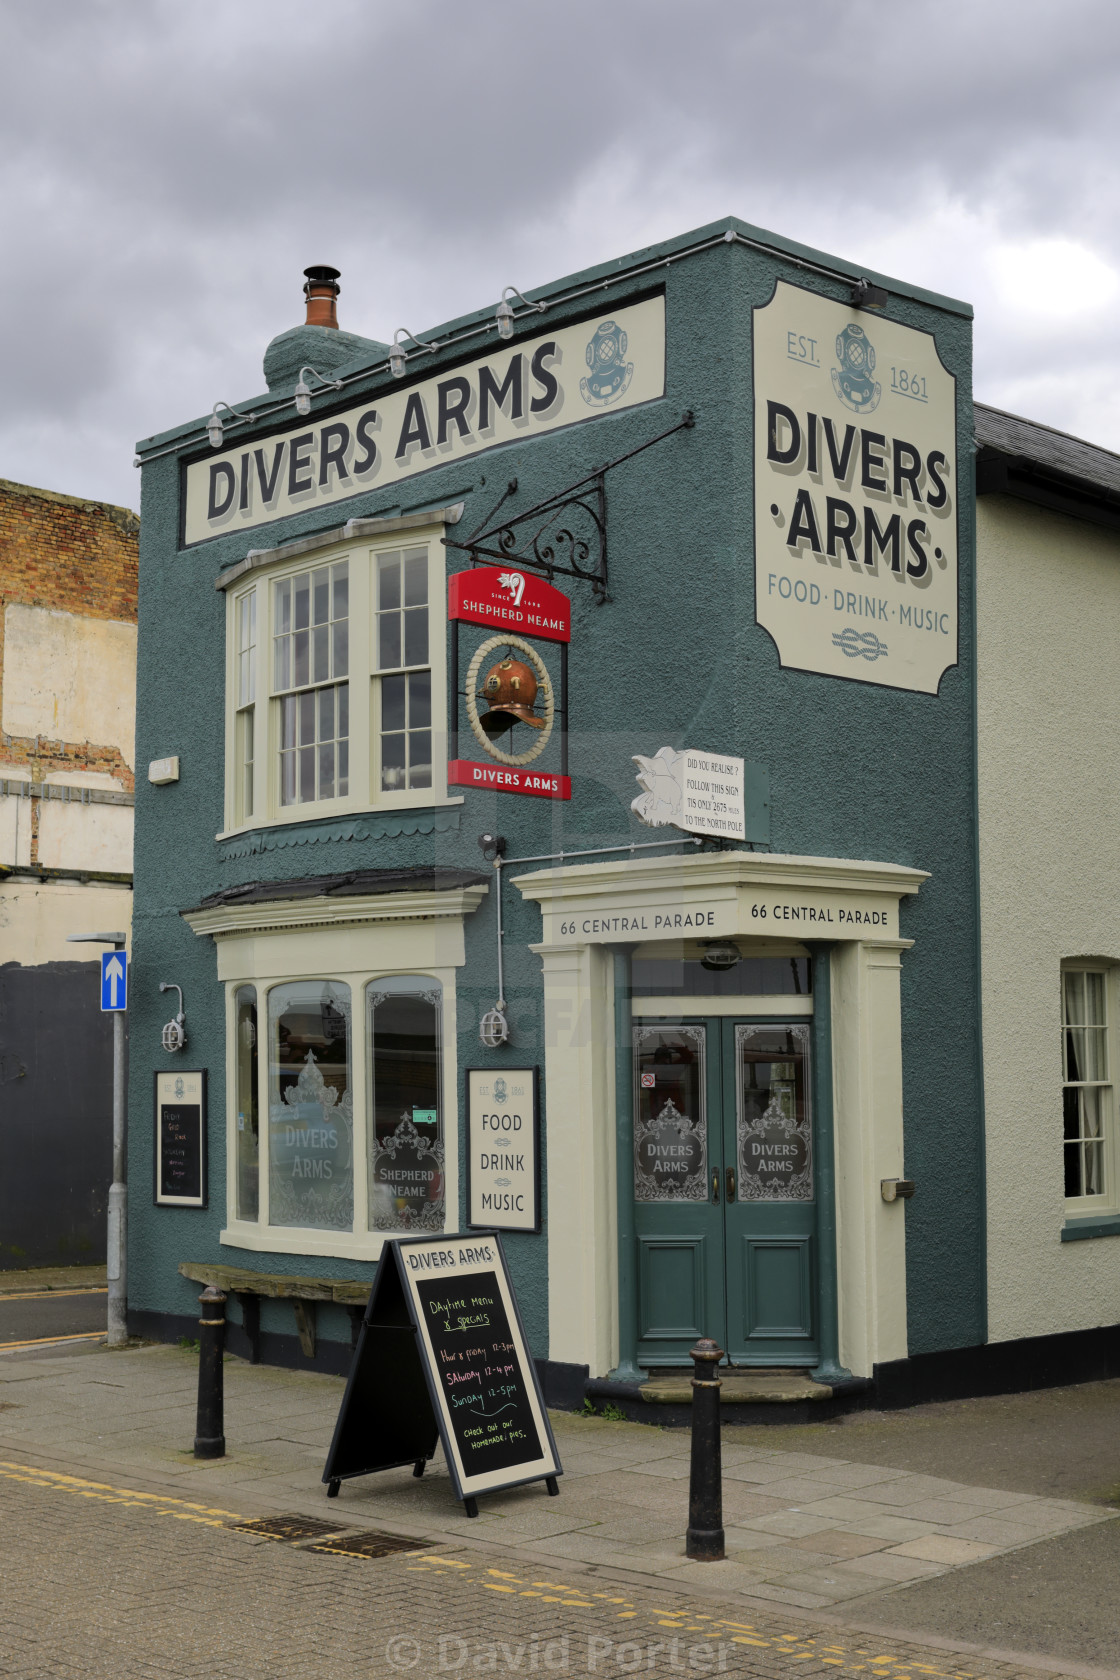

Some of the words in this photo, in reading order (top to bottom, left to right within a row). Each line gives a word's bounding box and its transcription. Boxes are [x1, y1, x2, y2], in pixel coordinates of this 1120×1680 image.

[787, 331, 820, 364] EST.
[890, 366, 928, 399] 1861
[207, 410, 380, 522] DIVERS
[395, 341, 560, 462] ARMS
[767, 399, 949, 509] DIVERS
[491, 592, 510, 601] SINCE
[524, 600, 541, 608] 1698
[768, 573, 821, 606] FOOD
[833, 594, 889, 622] DRINK
[900, 605, 949, 635] MUSIC
[463, 599, 524, 622] SHEPHERD
[527, 614, 565, 632] NEAME
[687, 758, 697, 769] DID
[698, 760, 709, 771] YOU
[711, 763, 734, 775] REALISE
[473, 768, 520, 785] DIVERS
[524, 776, 558, 792] ARMS
[687, 779, 709, 791] FOLLOW
[711, 783, 724, 795] THIS
[725, 786, 738, 797] SIGN
[687, 798, 696, 808] TIS
[697, 799, 711, 810] ONLY
[713, 801, 727, 813] 2675
[685, 814, 694, 825] TO
[694, 816, 706, 827] THE
[707, 818, 726, 830] NORTH
[728, 821, 743, 832] POLE
[560, 920, 576, 935] 66
[582, 915, 648, 934] CENTRAL
[654, 911, 715, 929] PARADE
[751, 904, 767, 919] 66
[773, 905, 834, 922] CENTRAL
[838, 909, 888, 926] PARADE
[482, 1114, 522, 1131] FOOD
[481, 1153, 525, 1171] DRINK
[482, 1193, 524, 1212] MUSIC
[409, 1250, 454, 1269] DIVERS
[459, 1246, 492, 1265] ARMS
[487, 1423, 498, 1432] out
[502, 1419, 513, 1429] our
